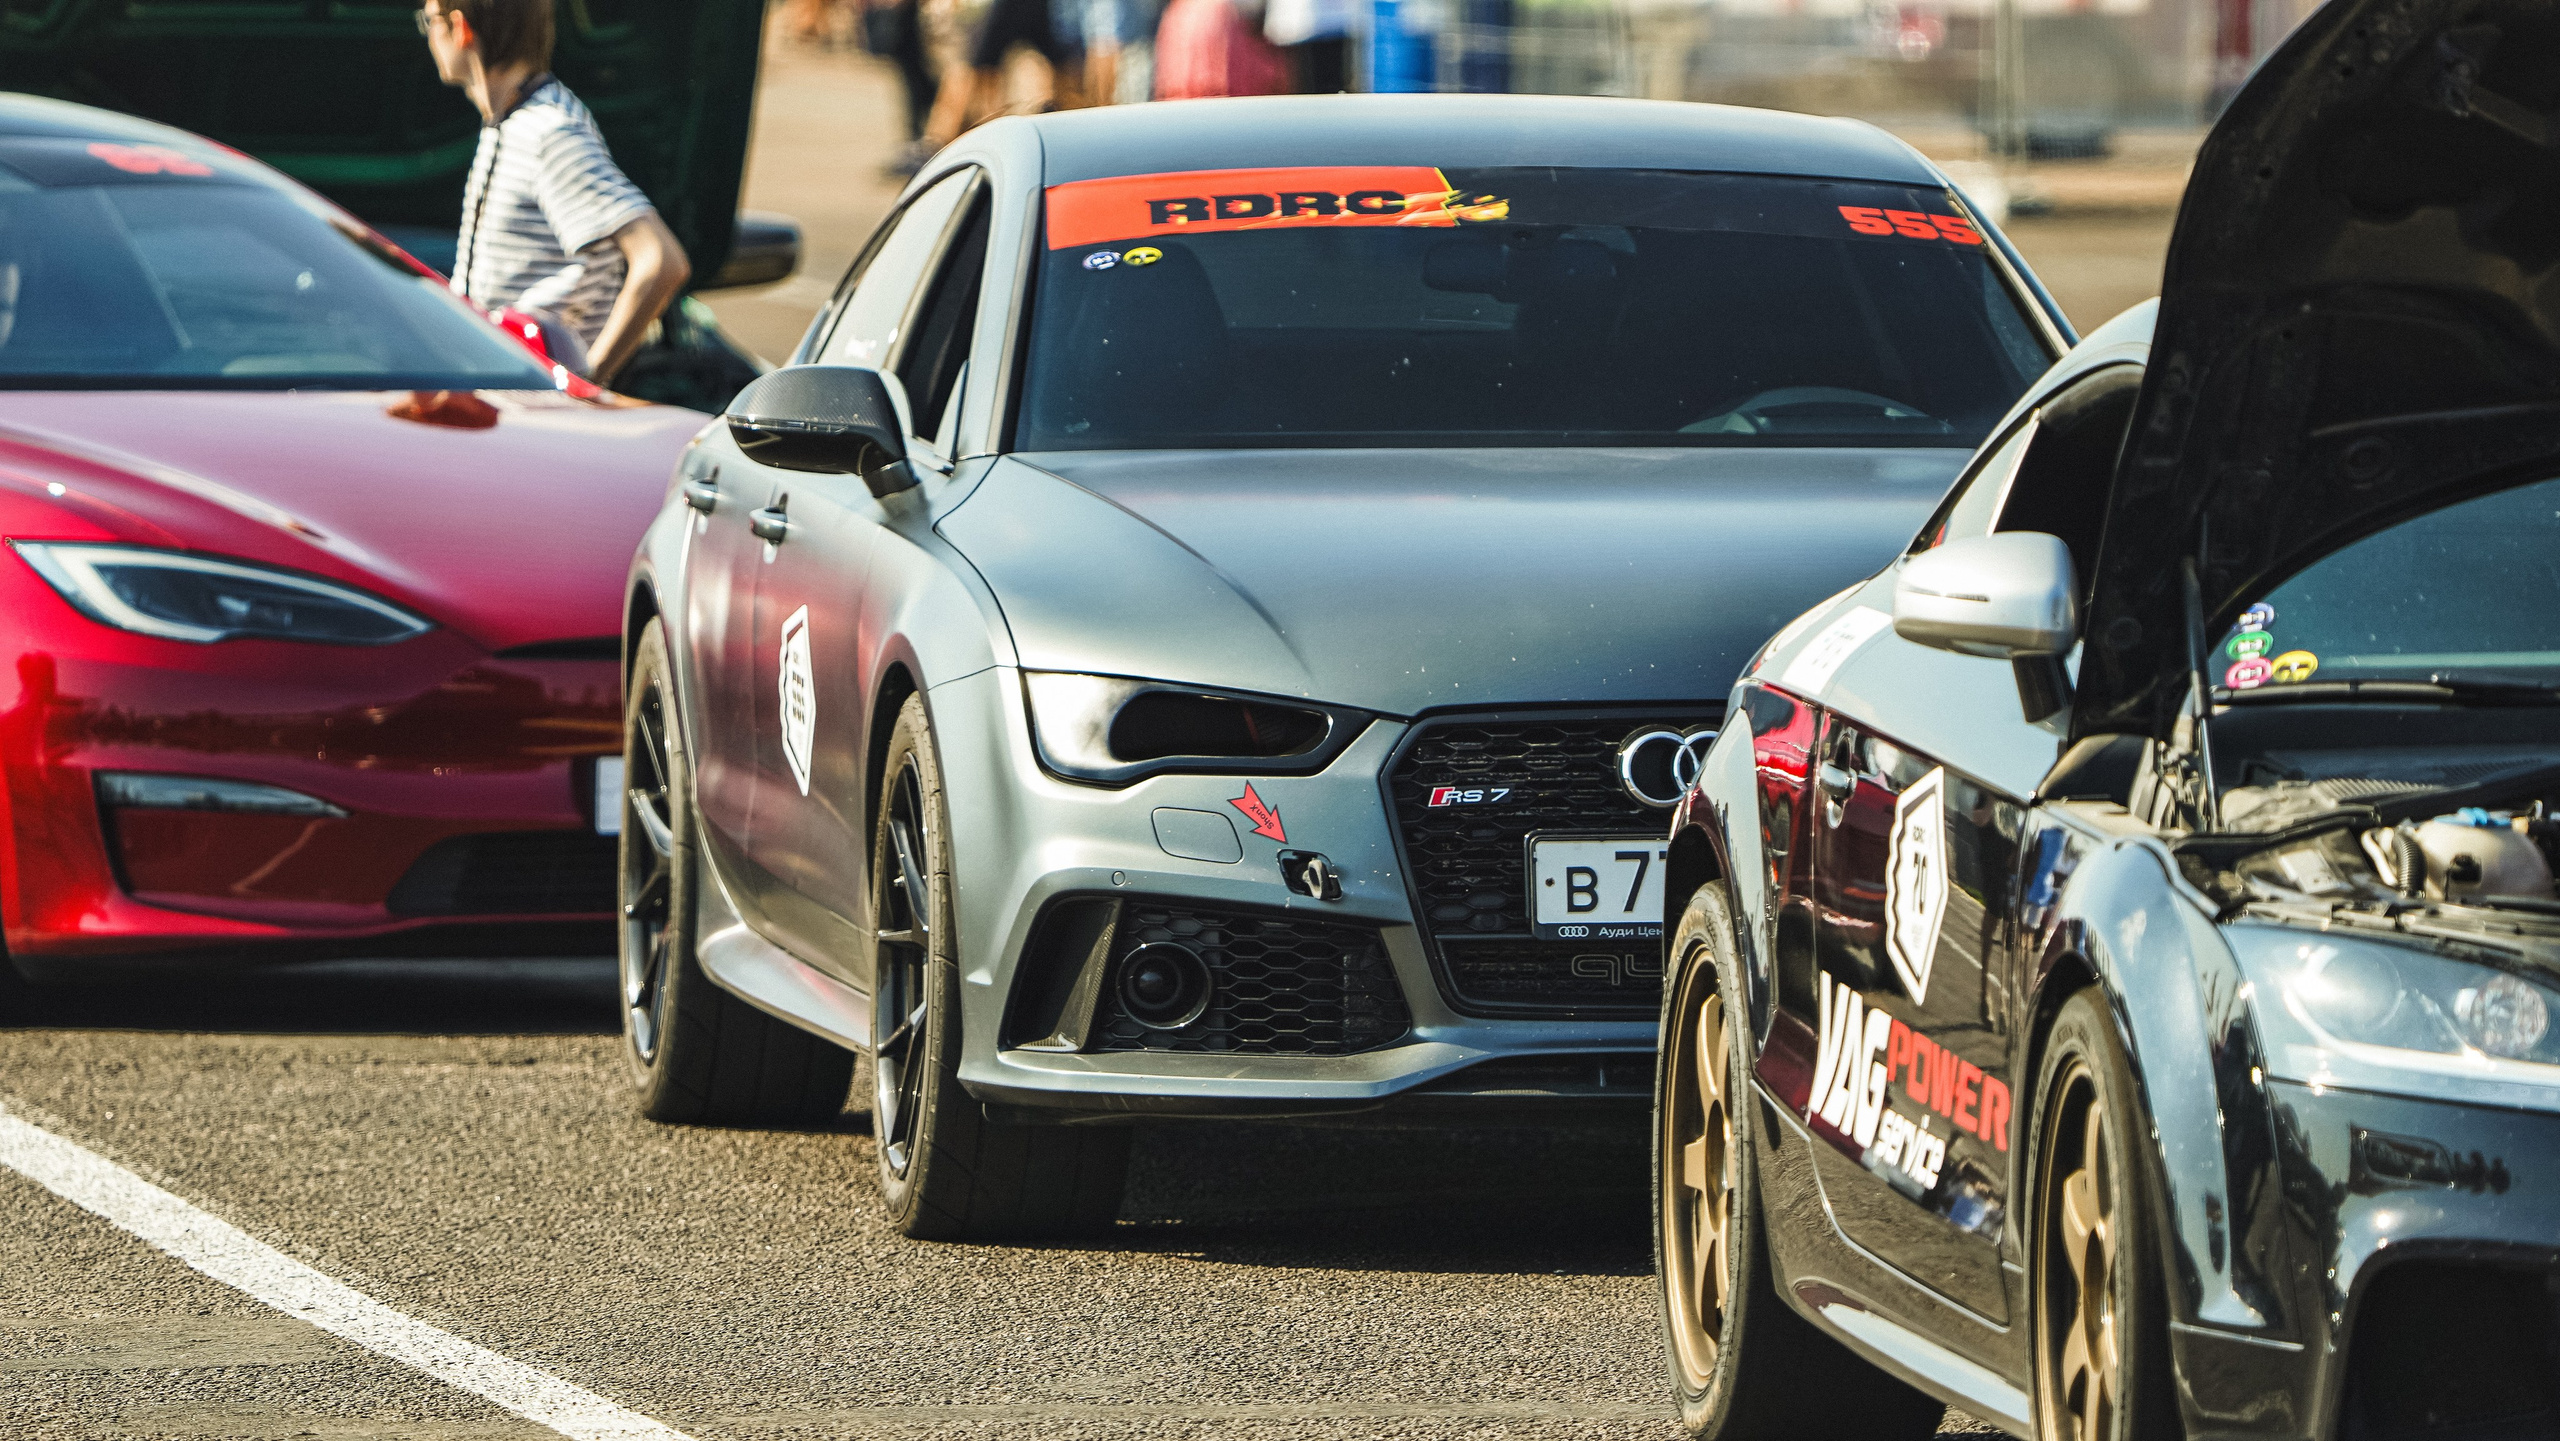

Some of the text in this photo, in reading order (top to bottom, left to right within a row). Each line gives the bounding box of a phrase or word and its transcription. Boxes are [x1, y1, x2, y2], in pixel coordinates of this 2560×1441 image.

[1146, 191, 1406, 224] RDRC
[1838, 205, 1983, 245] 555
[1438, 788, 1510, 804] RS 7
[1615, 850, 1667, 912] 7
[1599, 926, 1634, 938] Ауди
[1807, 969, 2011, 1151] VAG POWER
[1872, 1108, 1946, 1190] service
